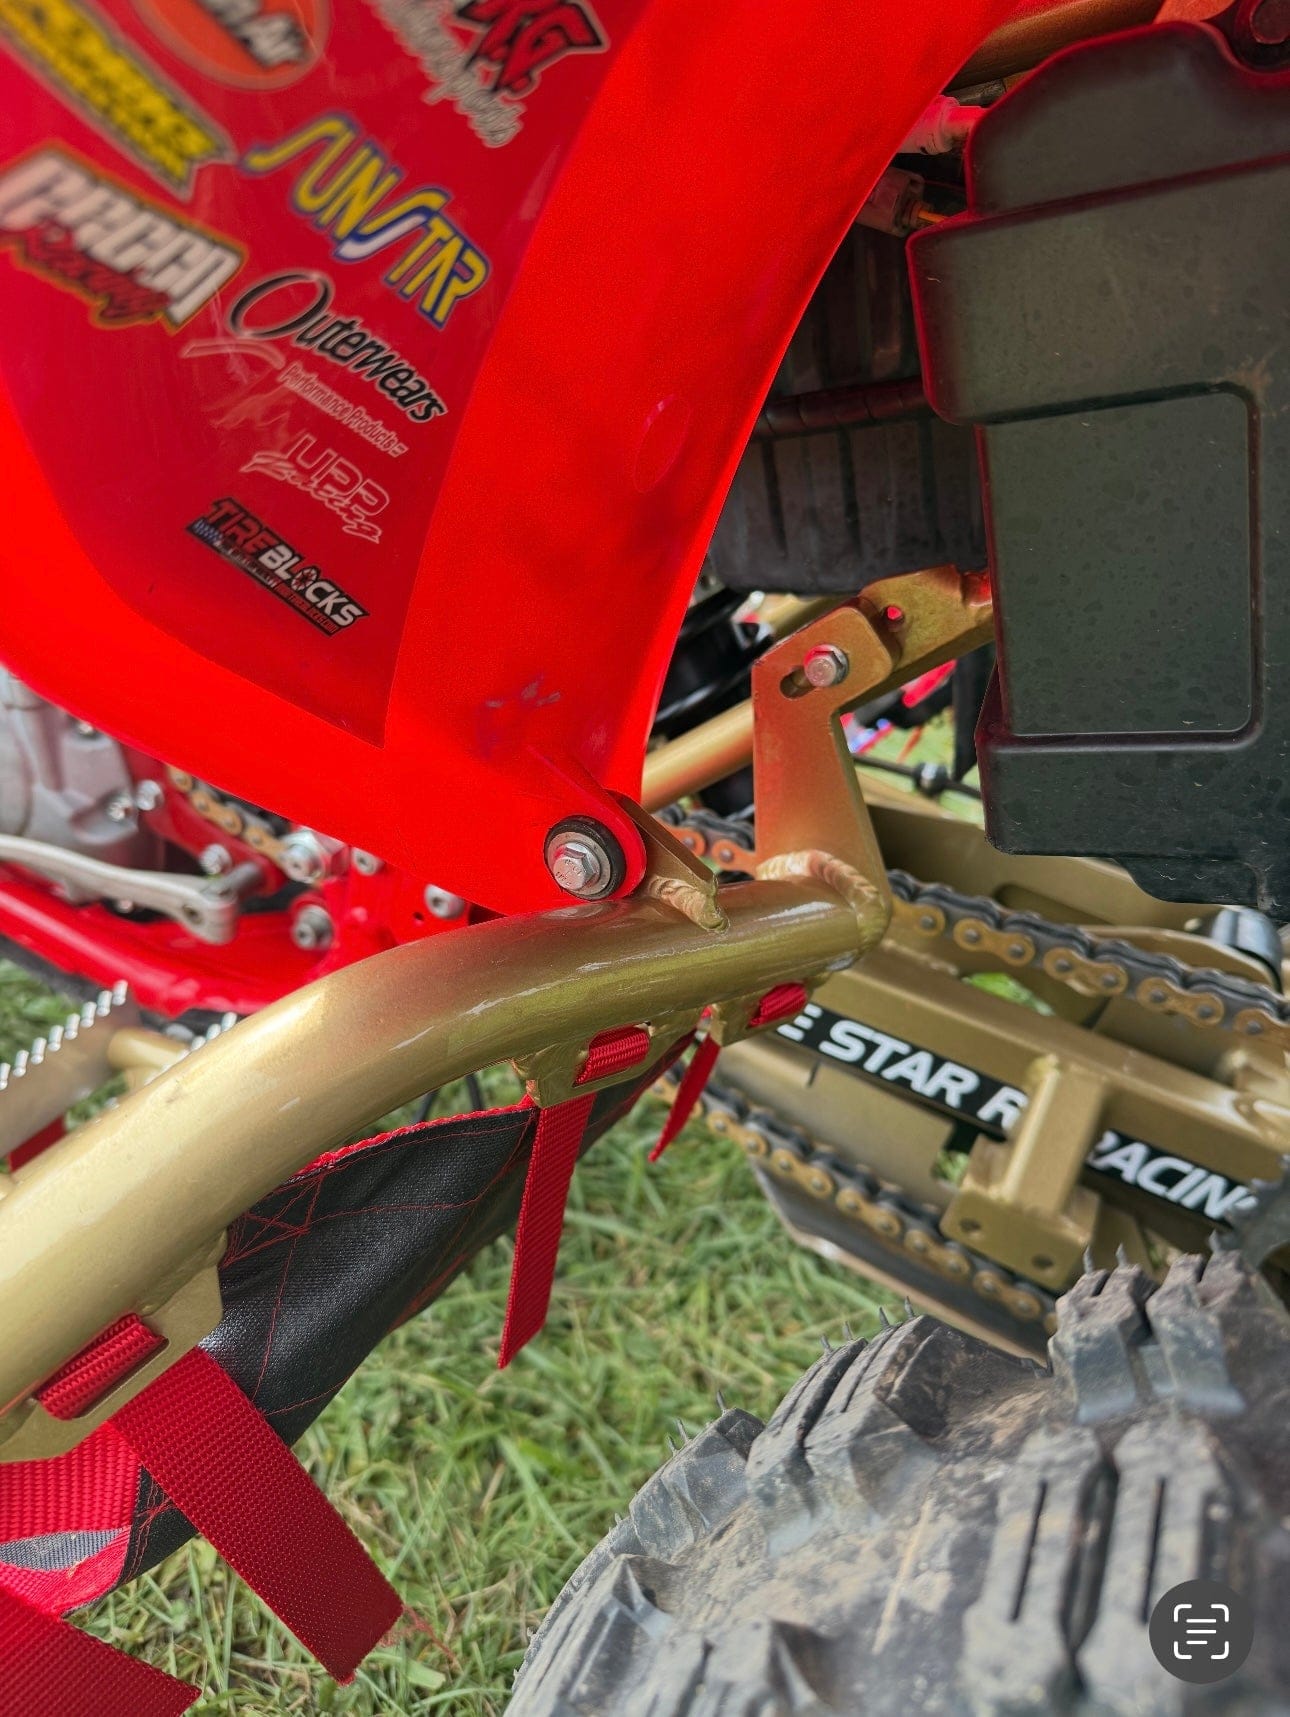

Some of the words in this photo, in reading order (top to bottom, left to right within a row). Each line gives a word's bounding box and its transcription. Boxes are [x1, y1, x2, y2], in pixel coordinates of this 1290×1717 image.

[241, 110, 491, 329] SUNSTAR
[229, 271, 447, 423] Outerwears
[277, 361, 356, 428] Performance
[819, 1020, 979, 1108] STAR
